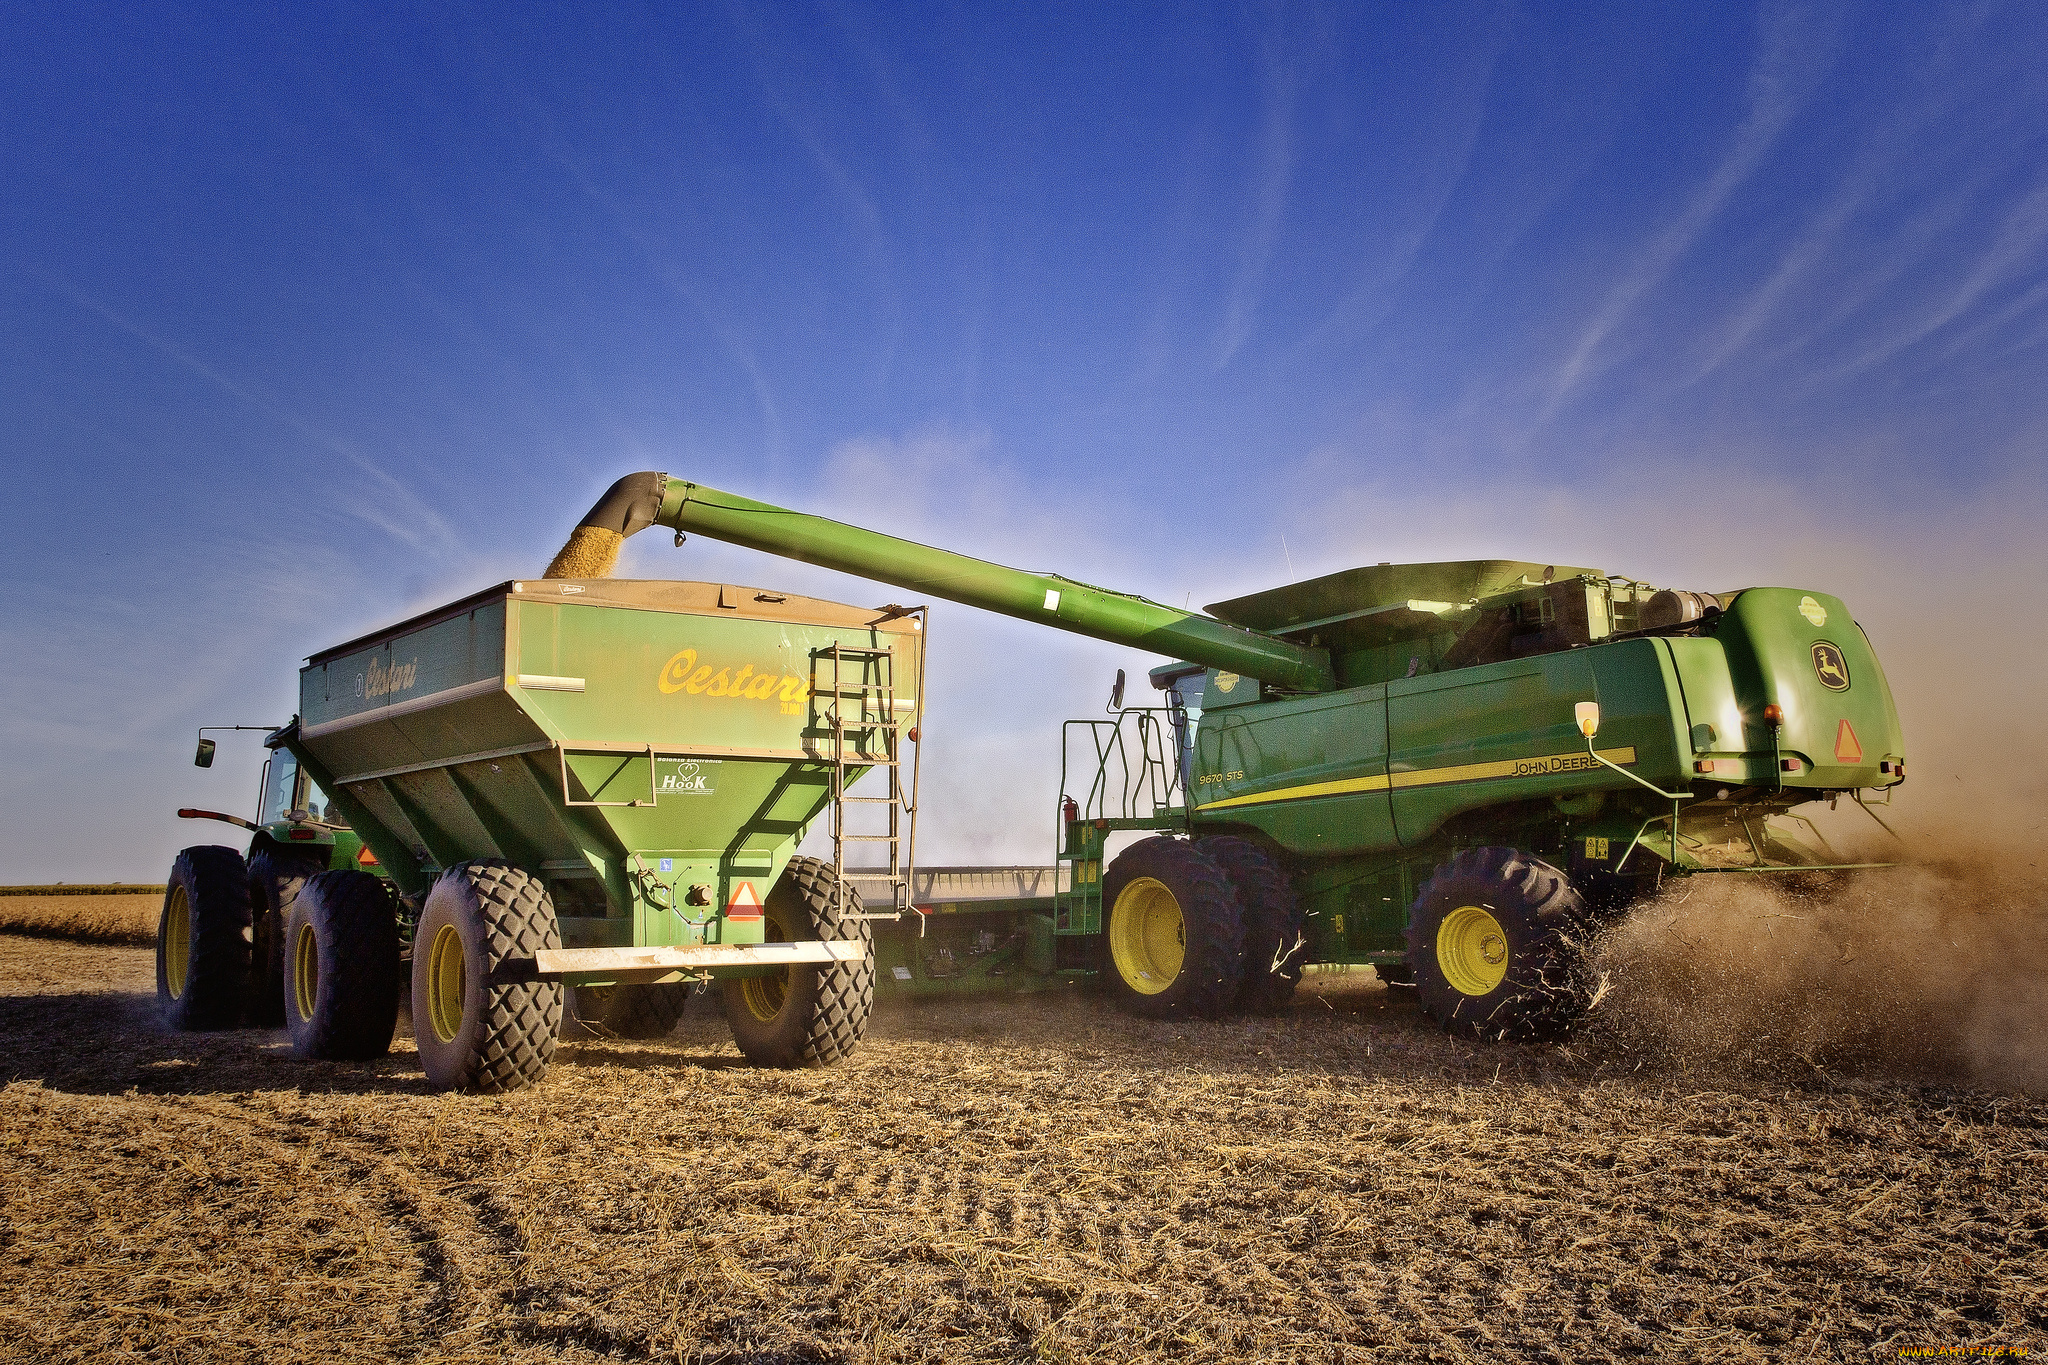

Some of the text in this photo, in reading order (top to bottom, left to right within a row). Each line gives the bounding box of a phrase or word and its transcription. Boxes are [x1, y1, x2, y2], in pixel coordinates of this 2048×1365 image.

[365, 657, 417, 699] Cestari
[658, 648, 816, 702] Cestari
[1199, 770, 1244, 784] 9670 STS
[1511, 757, 1598, 775] JOHN DEERE
